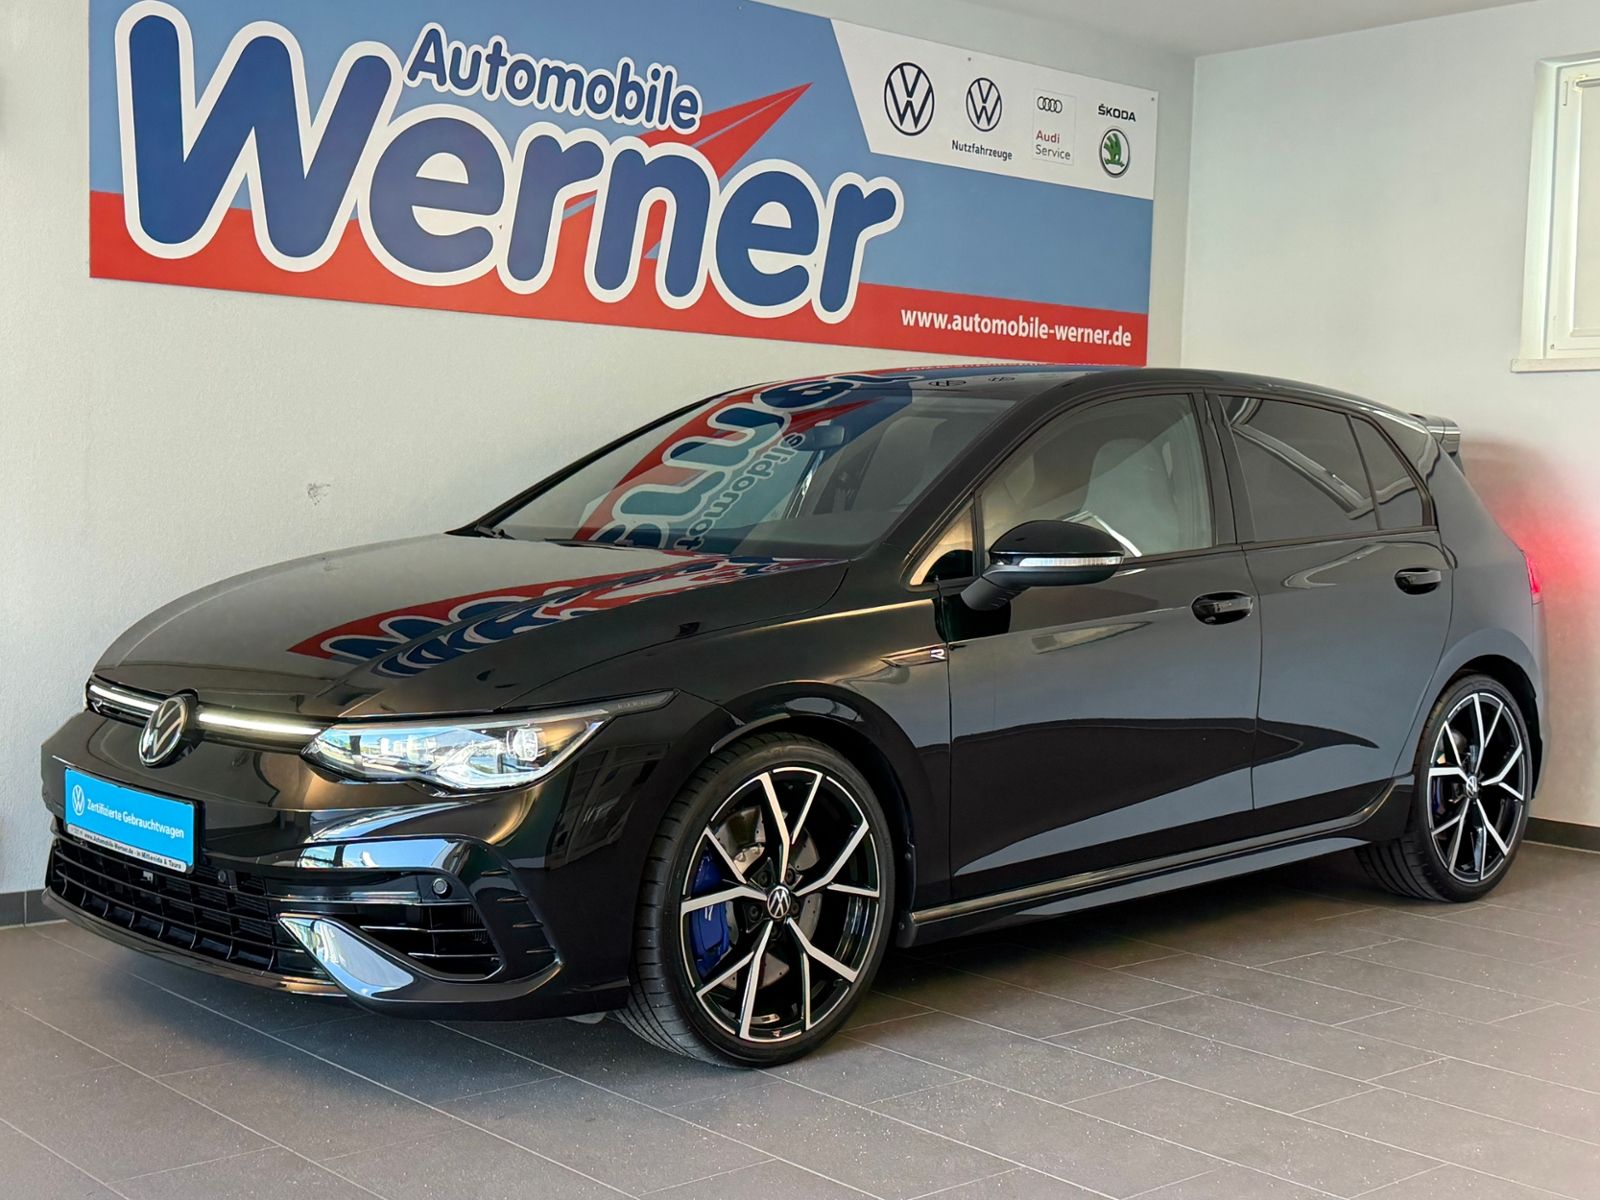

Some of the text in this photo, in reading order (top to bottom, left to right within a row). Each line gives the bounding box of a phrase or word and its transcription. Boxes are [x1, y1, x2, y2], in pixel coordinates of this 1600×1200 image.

[404, 24, 701, 133] Automobile
[884, 62, 935, 136] VW
[966, 77, 1002, 132] VW
[1098, 104, 1136, 122] ŠKODA
[951, 139, 1013, 161] Nutzfahrzeuge
[1035, 130, 1060, 144] Audi
[1035, 144, 1071, 160] Service
[118, 4, 902, 320] Werner
[900, 309, 1132, 347] www.automobile-werner.de
[87, 798, 185, 839] Zertifizierte Gebrauchtwagen
